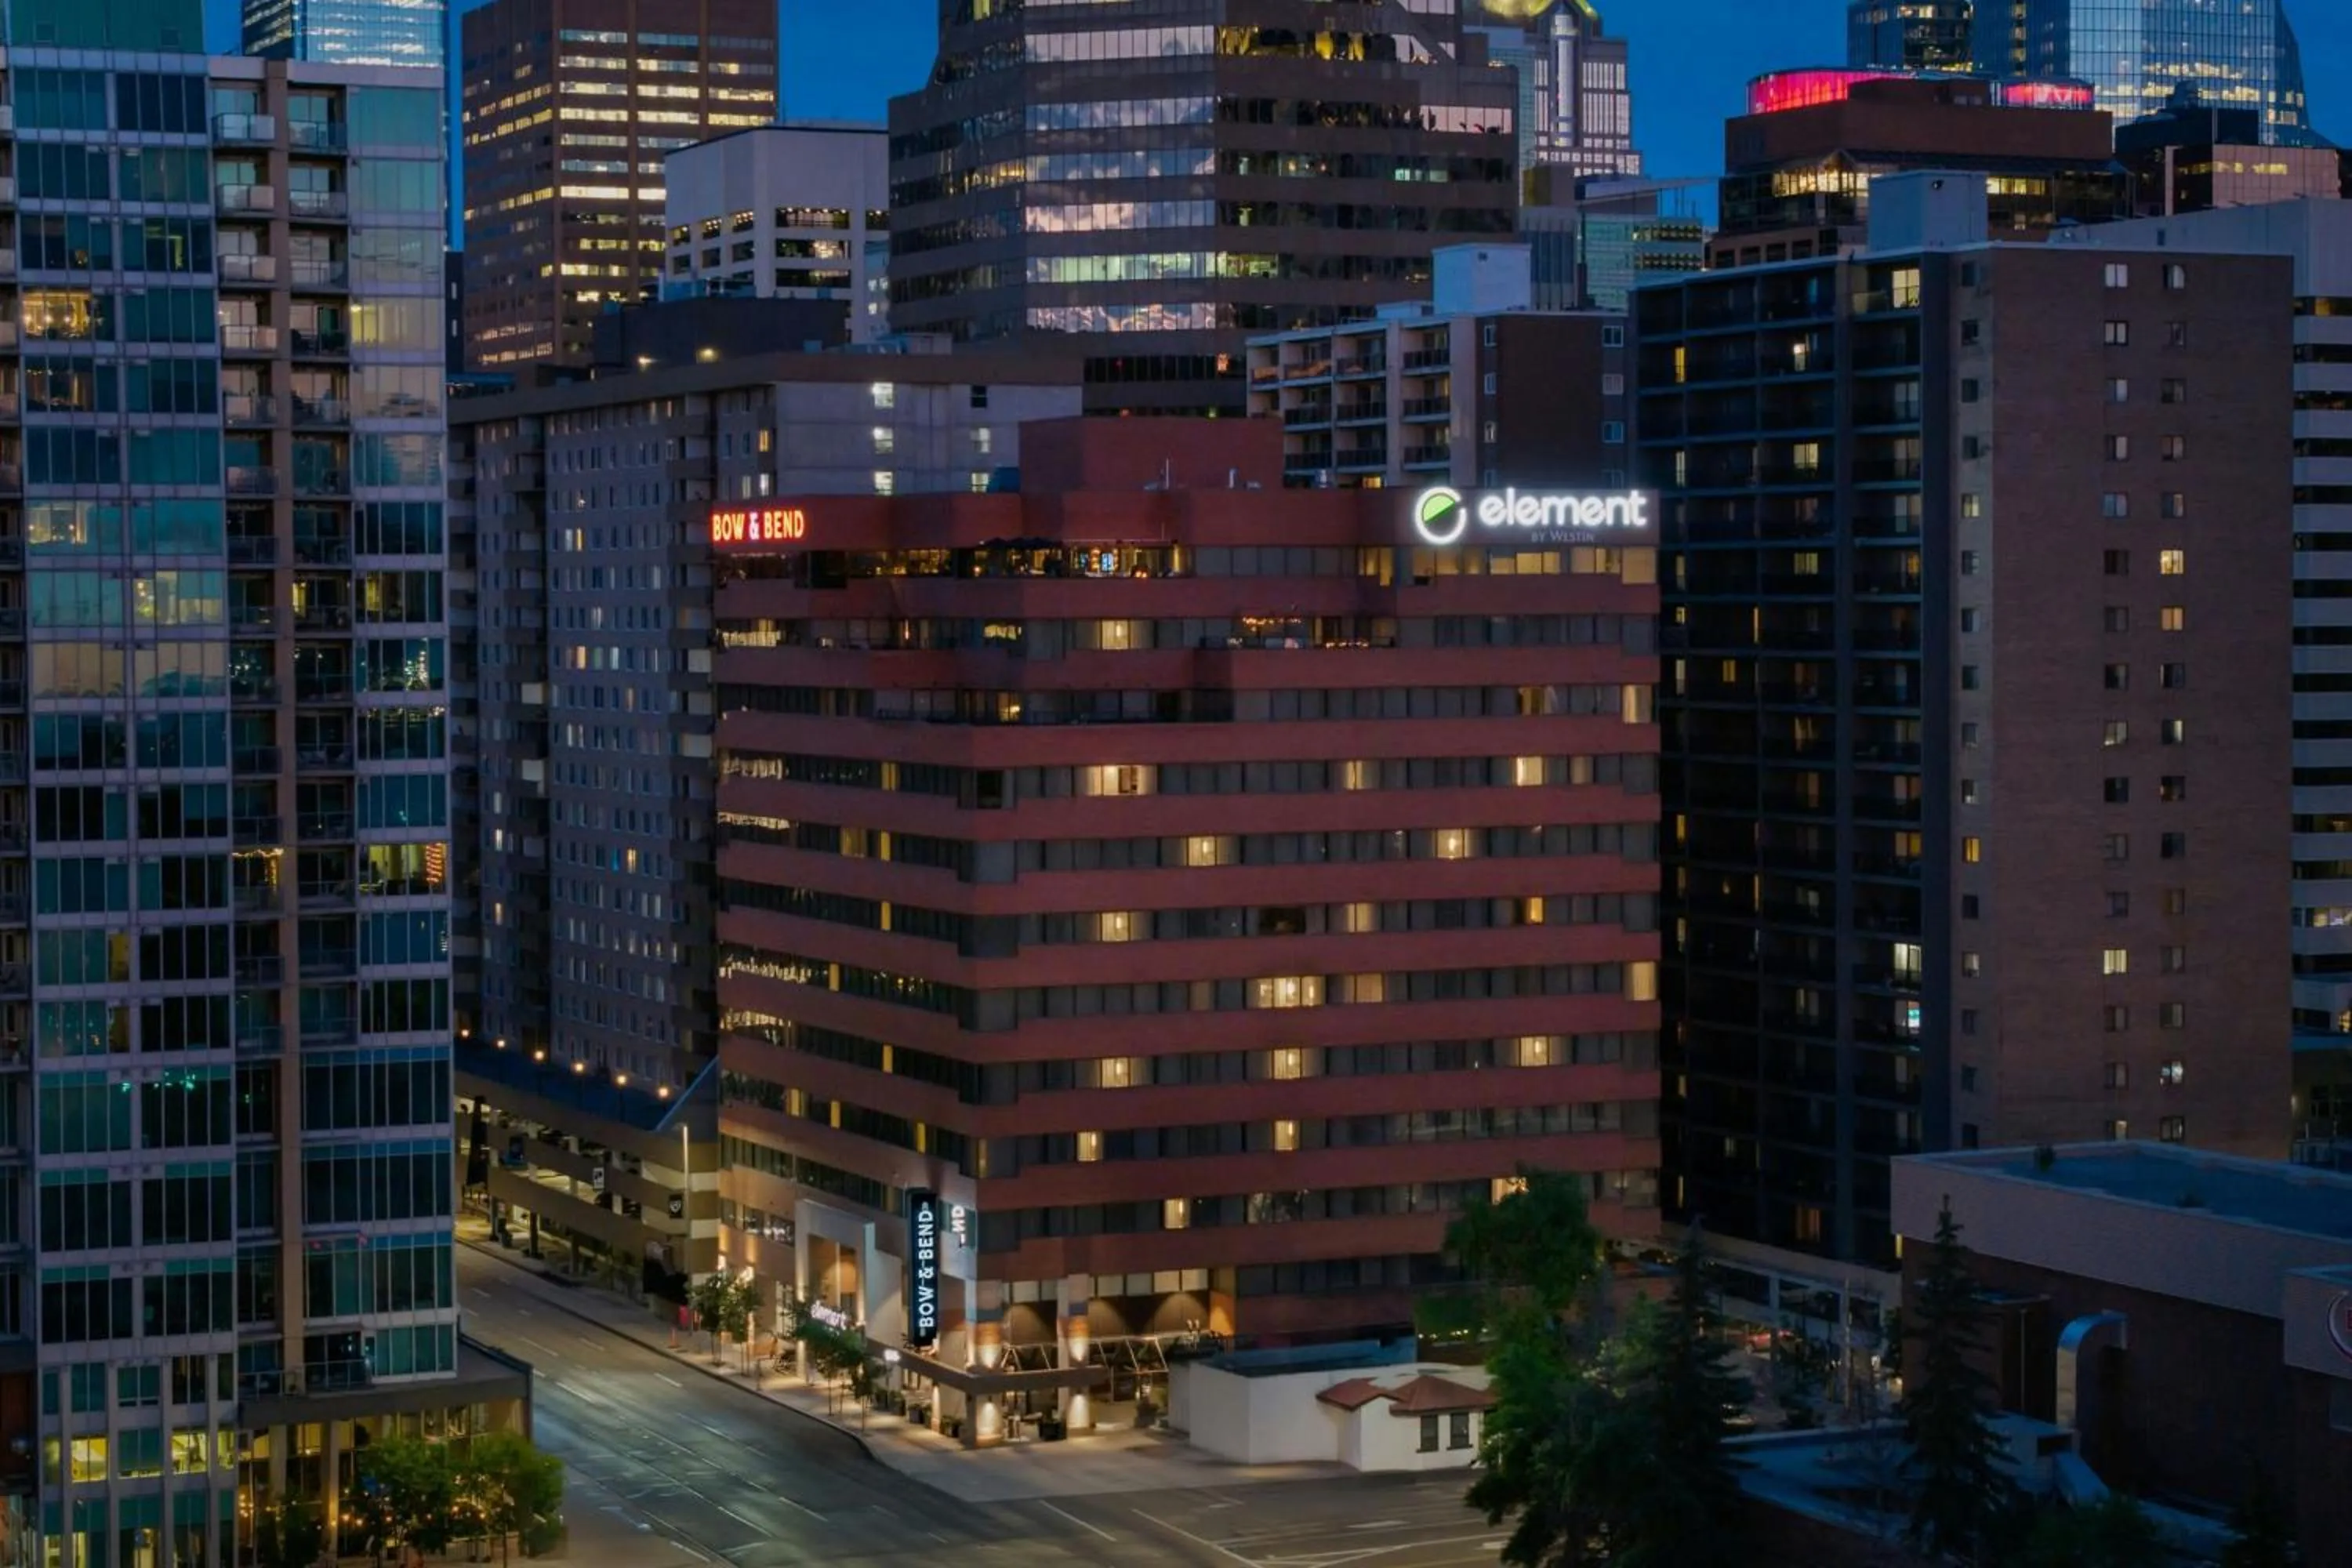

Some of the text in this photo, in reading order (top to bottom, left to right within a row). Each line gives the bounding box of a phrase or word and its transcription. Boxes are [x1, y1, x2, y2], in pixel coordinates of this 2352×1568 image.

[1479, 488, 1647, 526] element
[713, 510, 804, 540] BOW & BEND
[1531, 532, 1544, 543] BY
[918, 1210, 934, 1327] BOW & BEND
